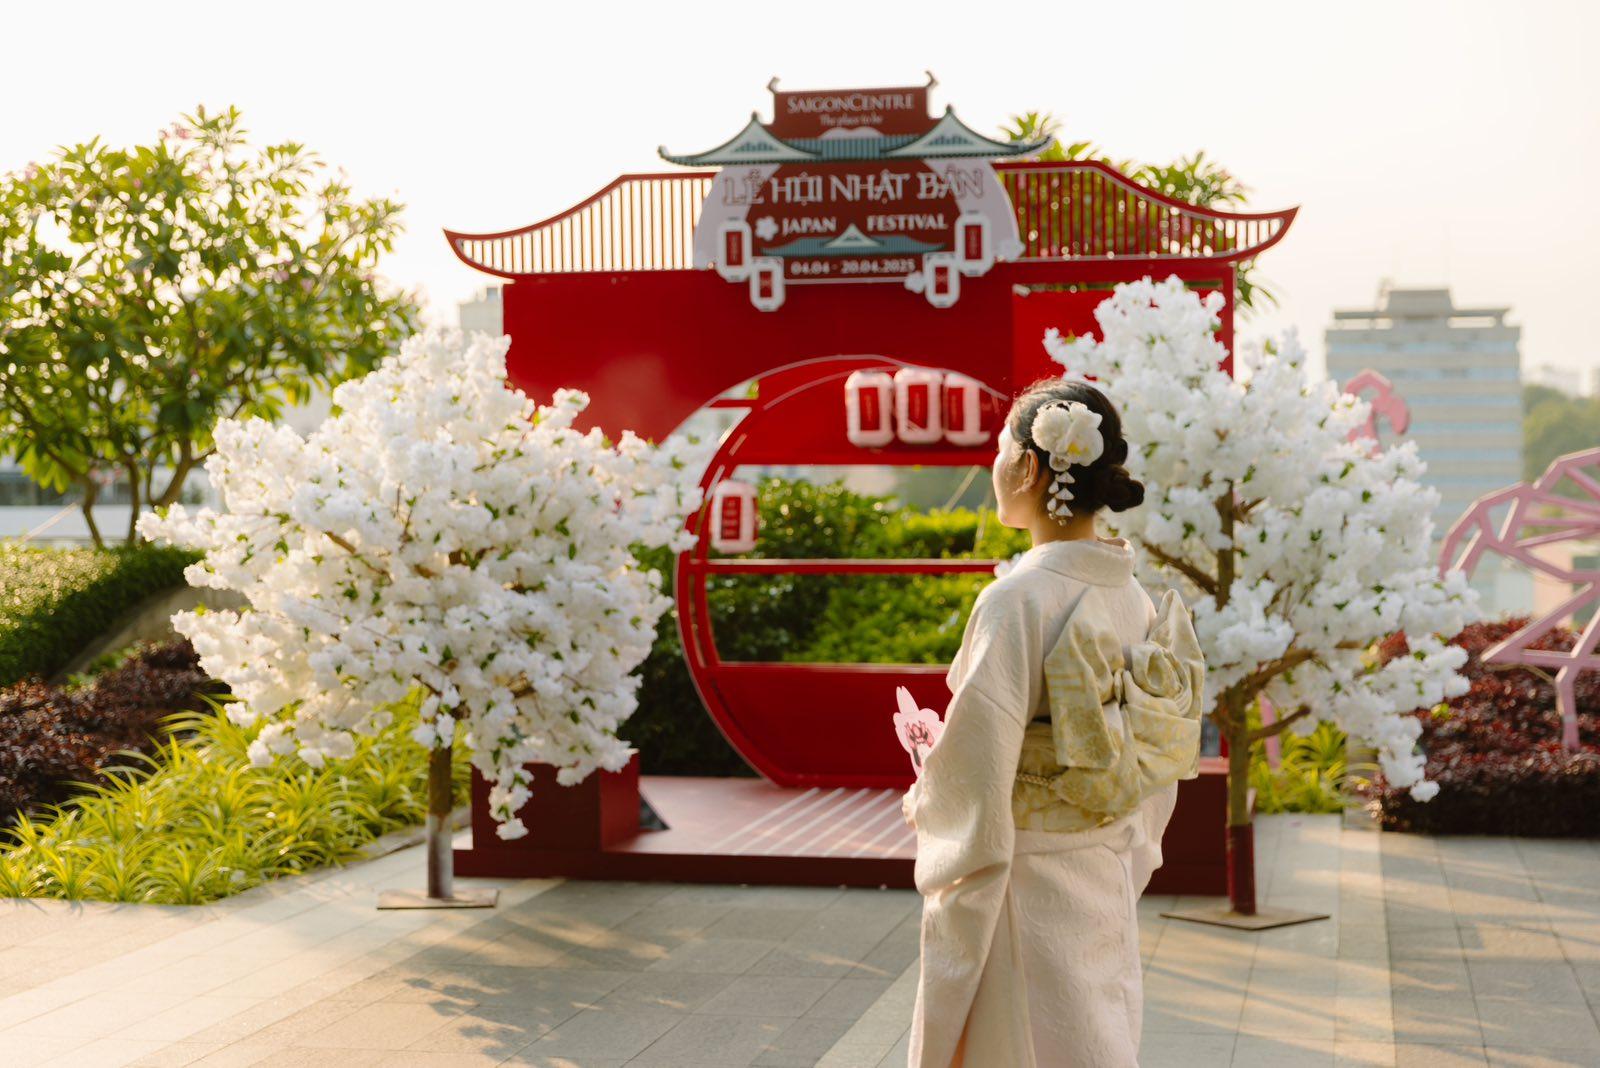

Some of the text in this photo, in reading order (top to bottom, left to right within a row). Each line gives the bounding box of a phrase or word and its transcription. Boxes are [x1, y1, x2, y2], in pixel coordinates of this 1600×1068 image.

[771, 171, 823, 206] HỘI
[830, 169, 910, 204] NHẬT
[918, 164, 984, 201] BẢN
[782, 213, 948, 236] JAPAN FESTIVAL
